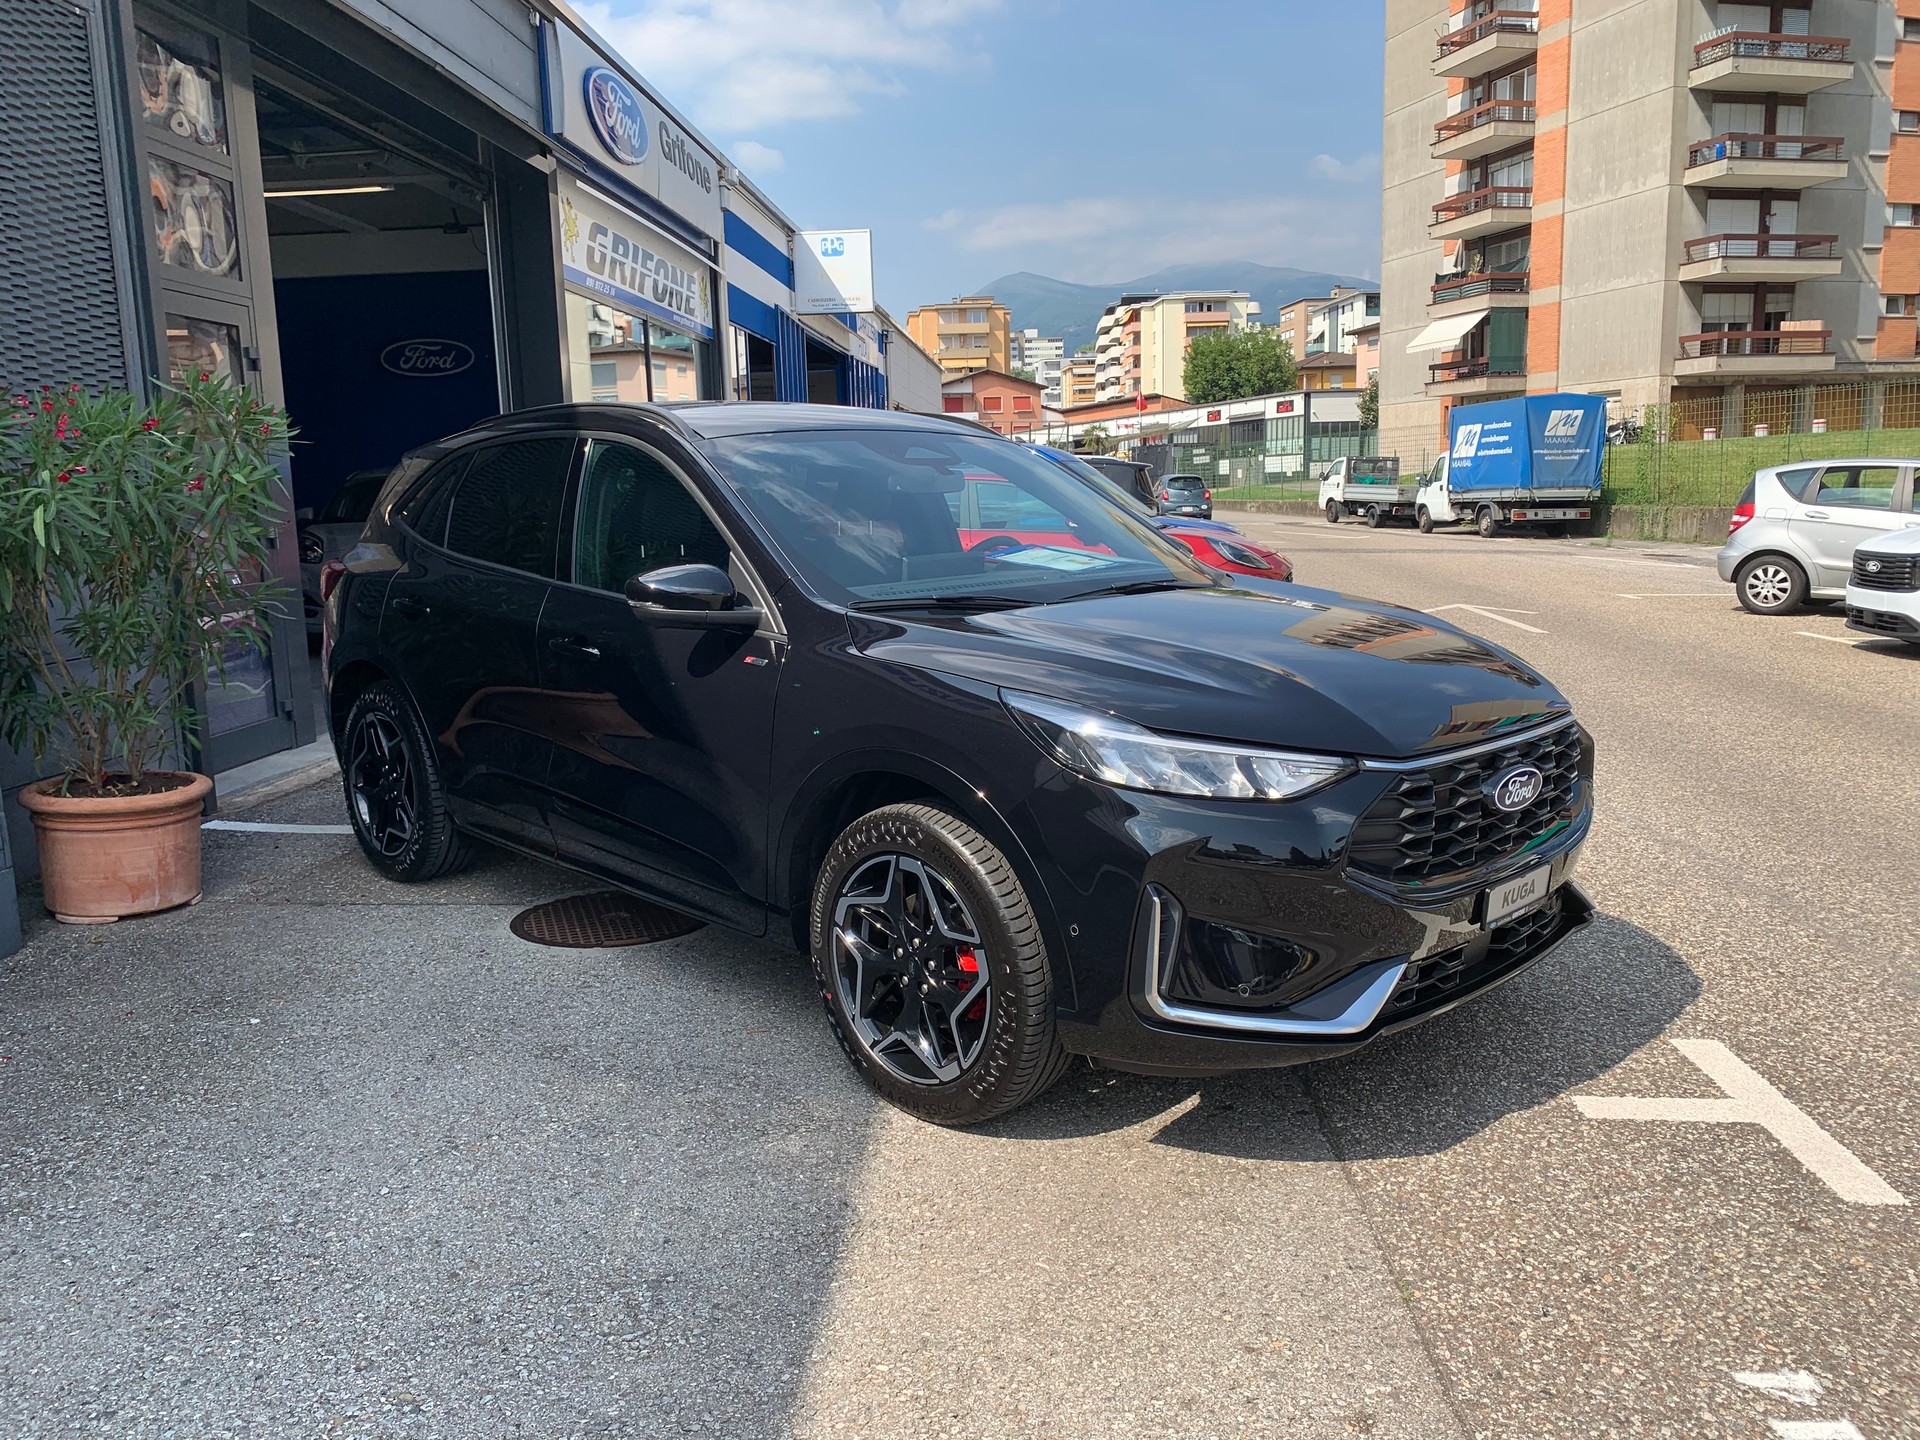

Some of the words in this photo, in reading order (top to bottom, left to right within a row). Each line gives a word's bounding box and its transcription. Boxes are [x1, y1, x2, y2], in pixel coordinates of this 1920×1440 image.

[604, 80, 641, 149] Ford
[658, 120, 712, 194] Grifone
[821, 237, 844, 254] PPG
[586, 221, 697, 318] GRIFONE
[399, 344, 457, 369] Ford
[1505, 774, 1535, 806] Ford
[1501, 878, 1536, 910] KUGA
